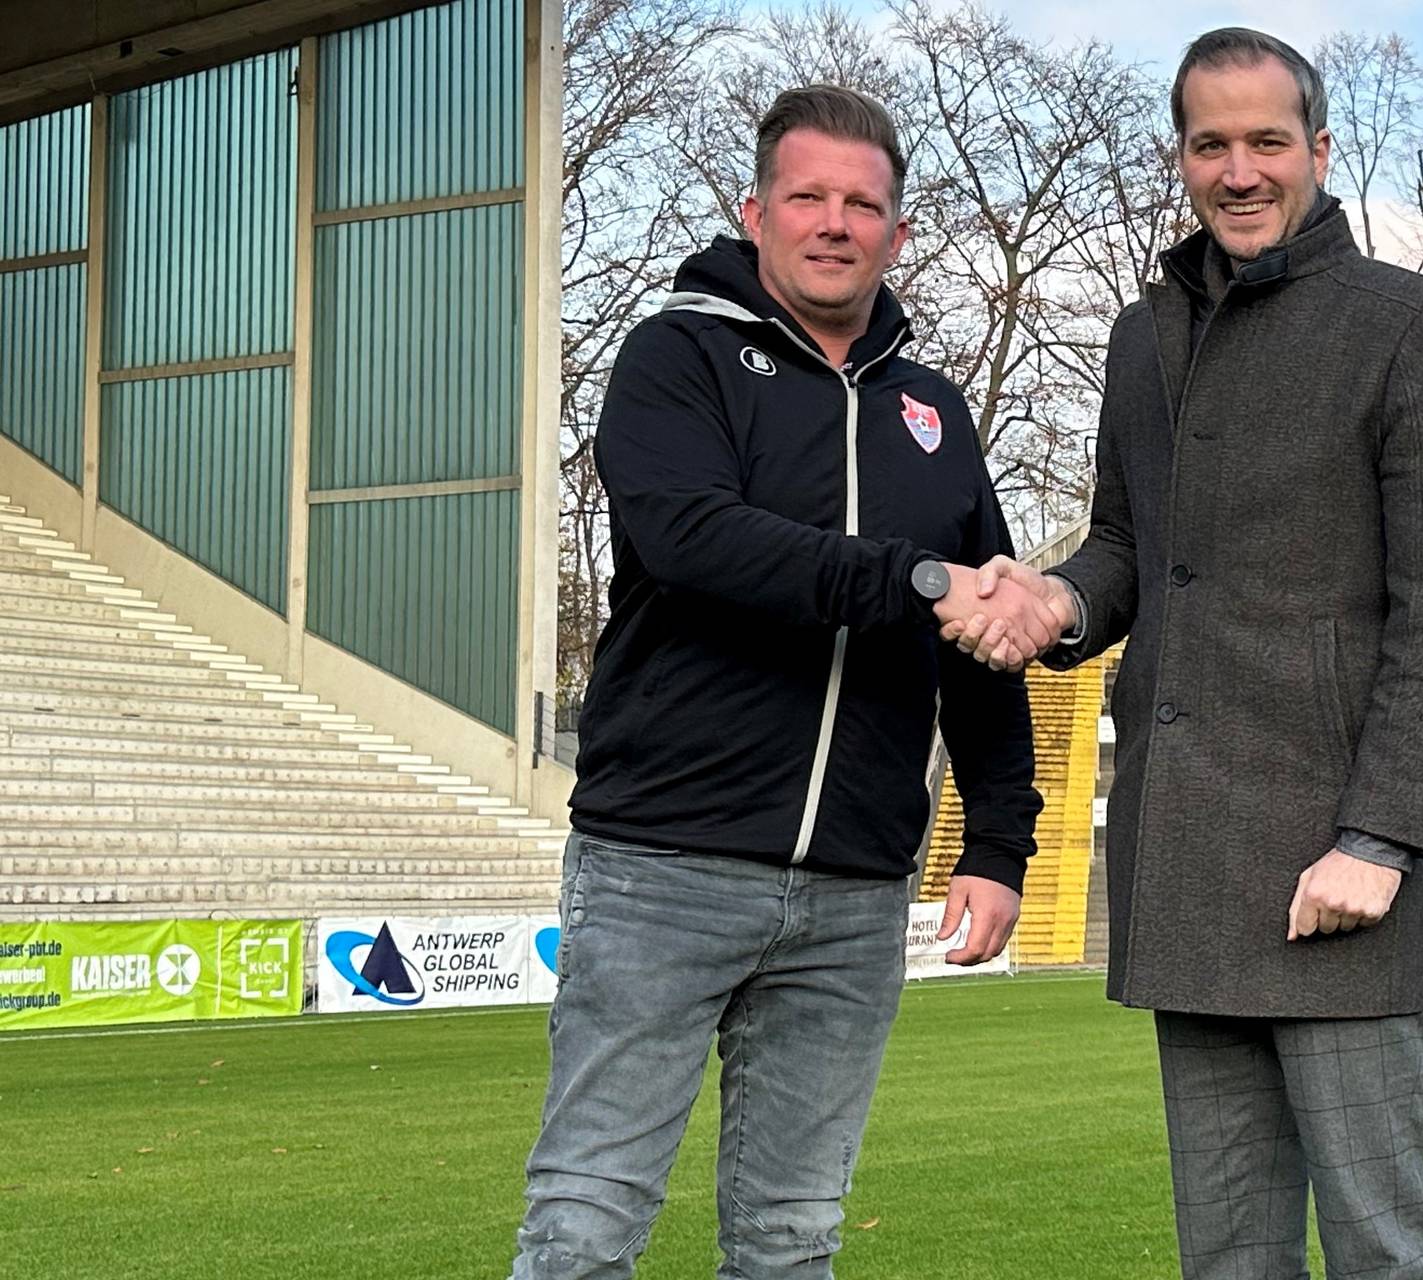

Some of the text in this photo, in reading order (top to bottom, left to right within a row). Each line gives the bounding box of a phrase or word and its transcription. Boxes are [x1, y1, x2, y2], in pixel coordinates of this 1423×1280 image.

[911, 920, 938, 932] HOTEL
[412, 932, 505, 951] ANTWERP
[248, 961, 283, 975] KICK
[423, 952, 499, 972] GLOBAL
[71, 954, 152, 992] KAISER
[432, 973, 520, 992] SHIPPING
